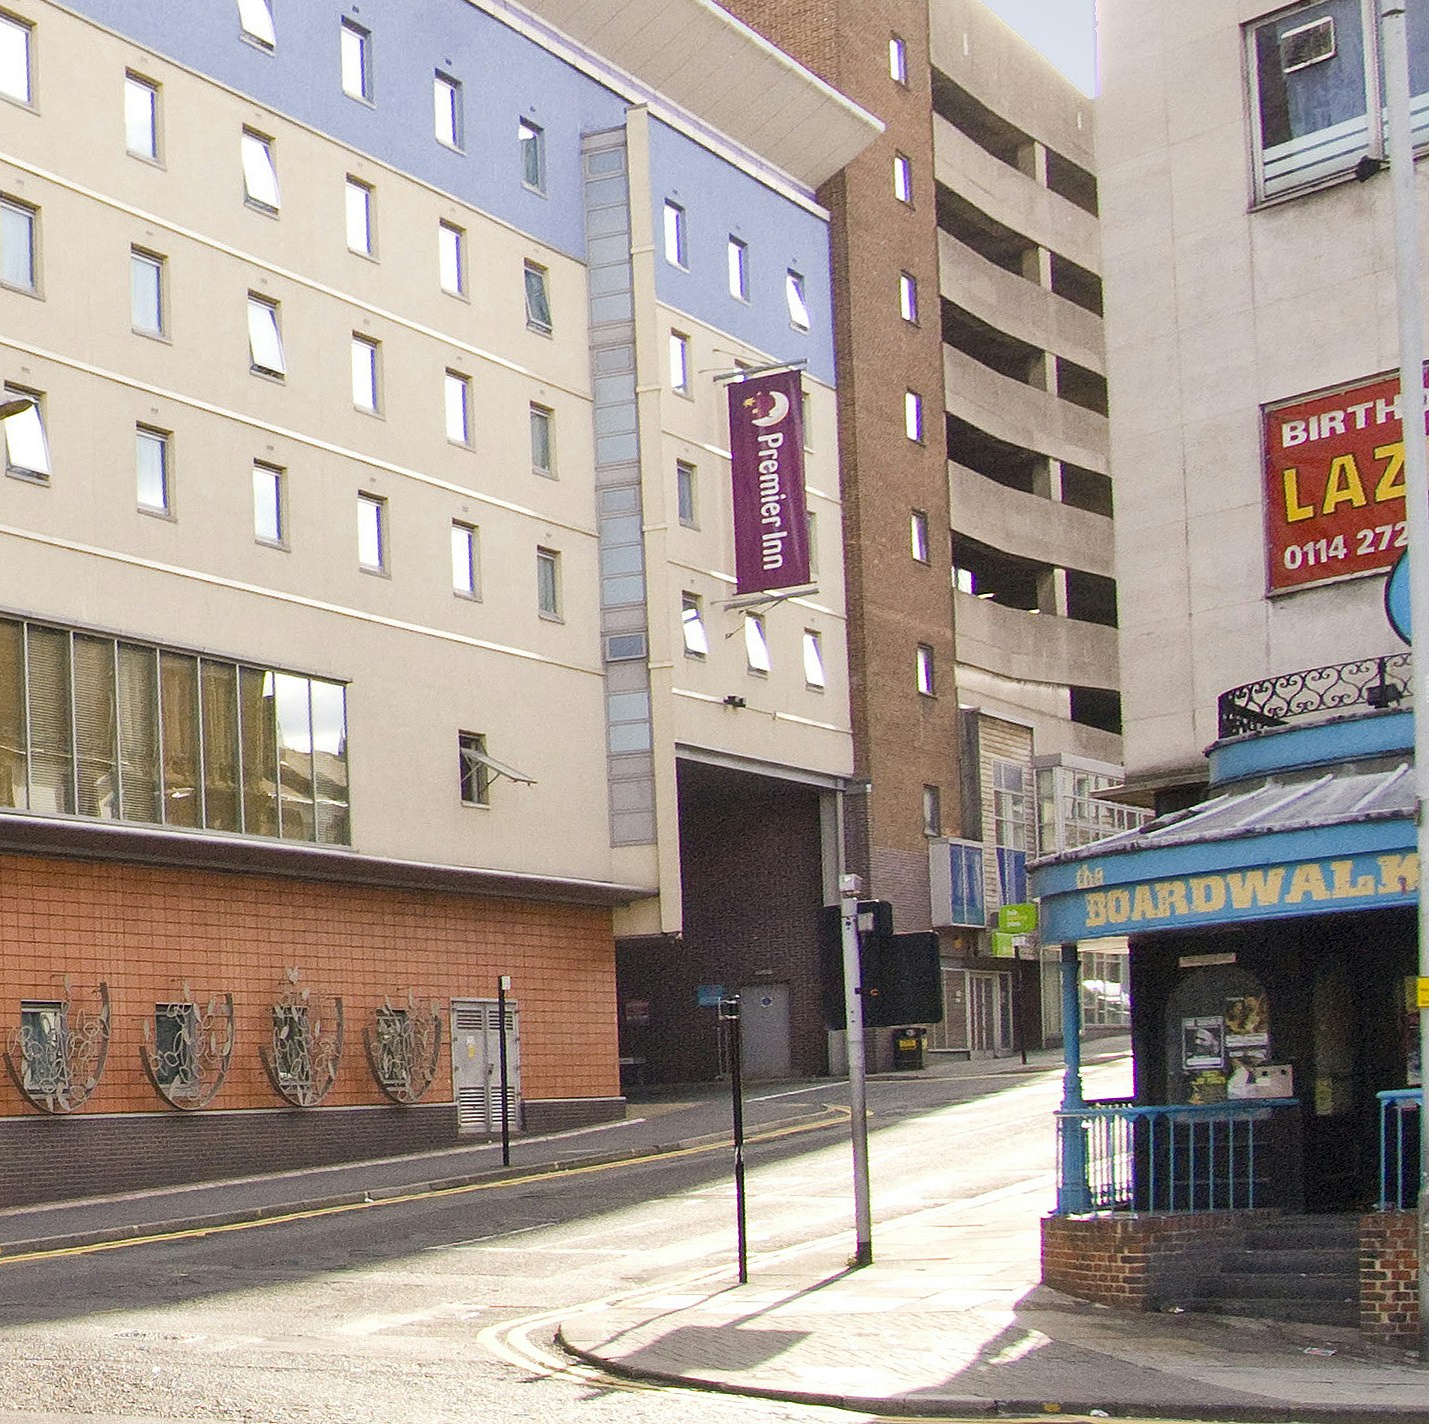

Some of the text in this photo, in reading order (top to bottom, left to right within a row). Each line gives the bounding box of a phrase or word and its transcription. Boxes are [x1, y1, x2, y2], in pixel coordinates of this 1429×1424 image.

[757, 432, 788, 571] Premier Inn
[1283, 441, 1407, 523] LAZ
[1284, 534, 1347, 570] 0114
[1076, 863, 1104, 889] the
[1086, 852, 1421, 927] BOARDWALK
